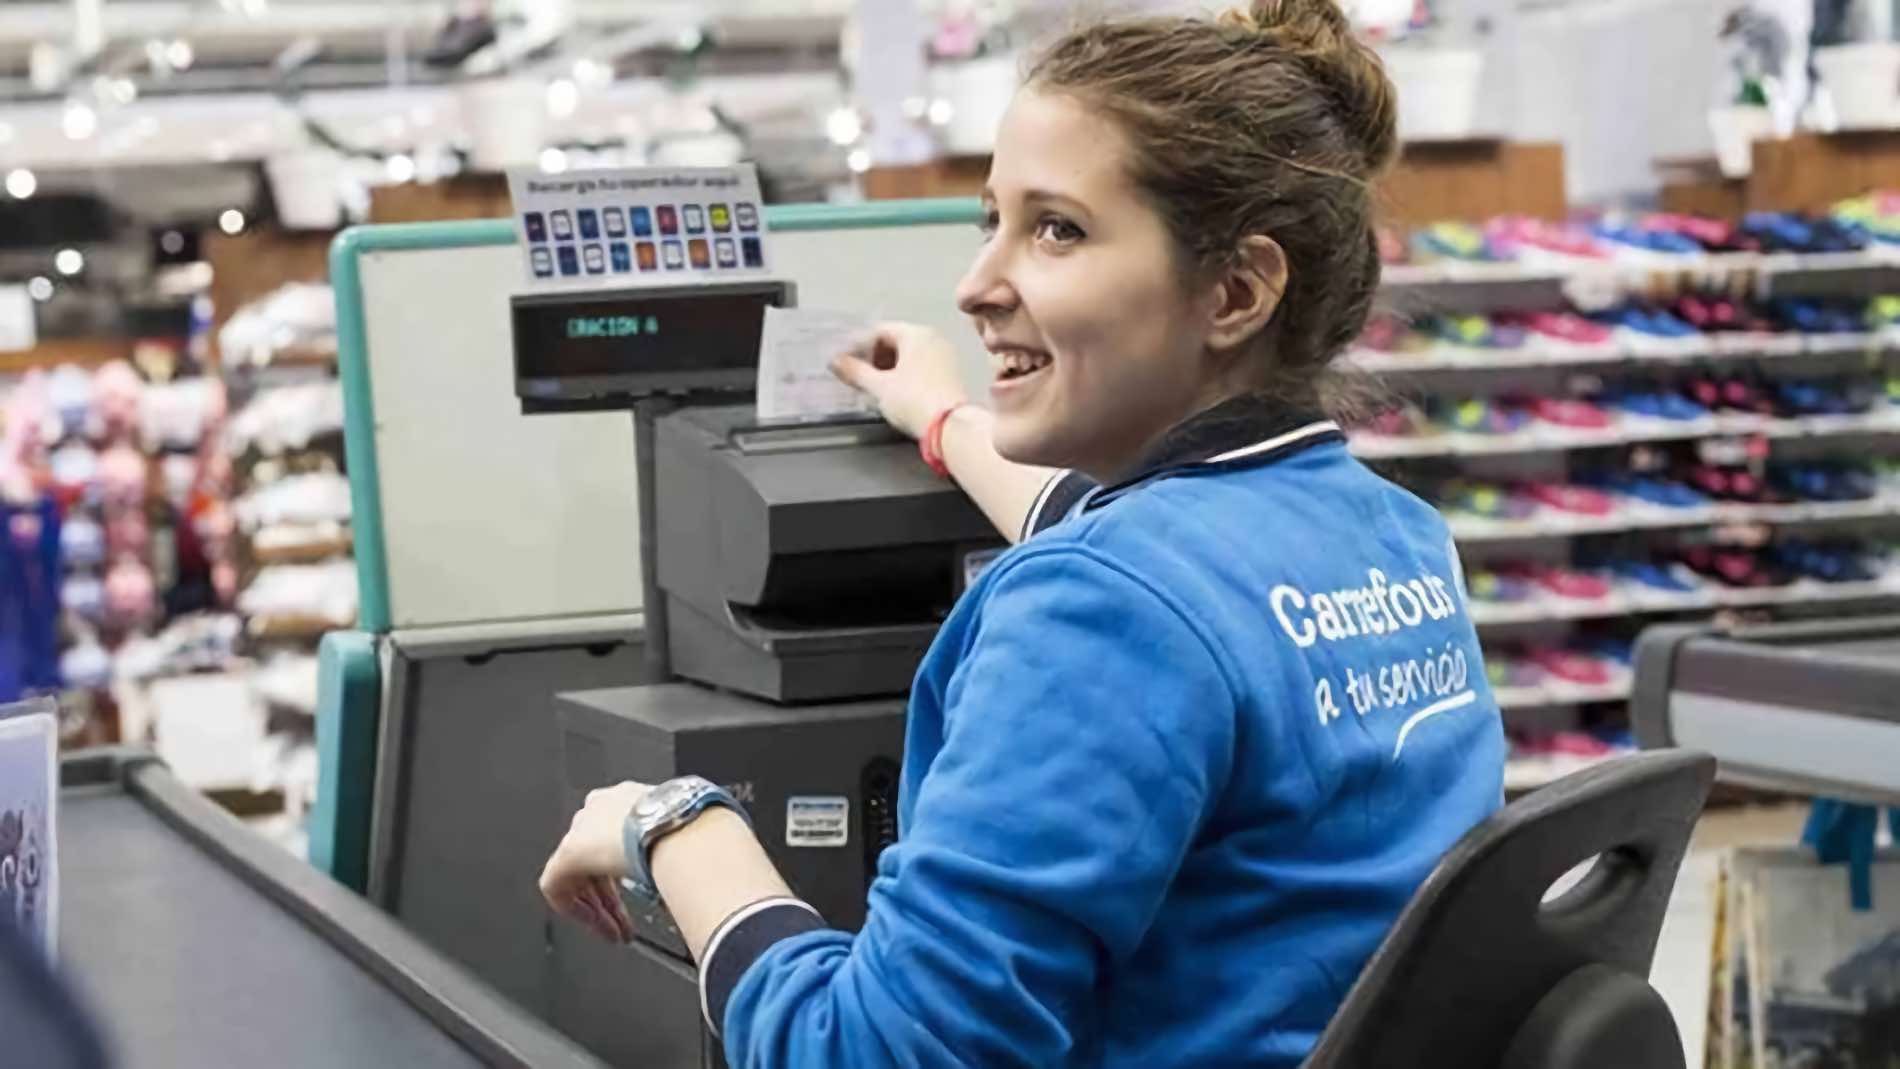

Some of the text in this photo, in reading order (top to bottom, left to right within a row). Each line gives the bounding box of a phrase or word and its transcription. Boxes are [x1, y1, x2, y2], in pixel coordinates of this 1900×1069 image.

[1269, 567, 1456, 648] Carrefour
[1315, 641, 1467, 726] a tu servicio
